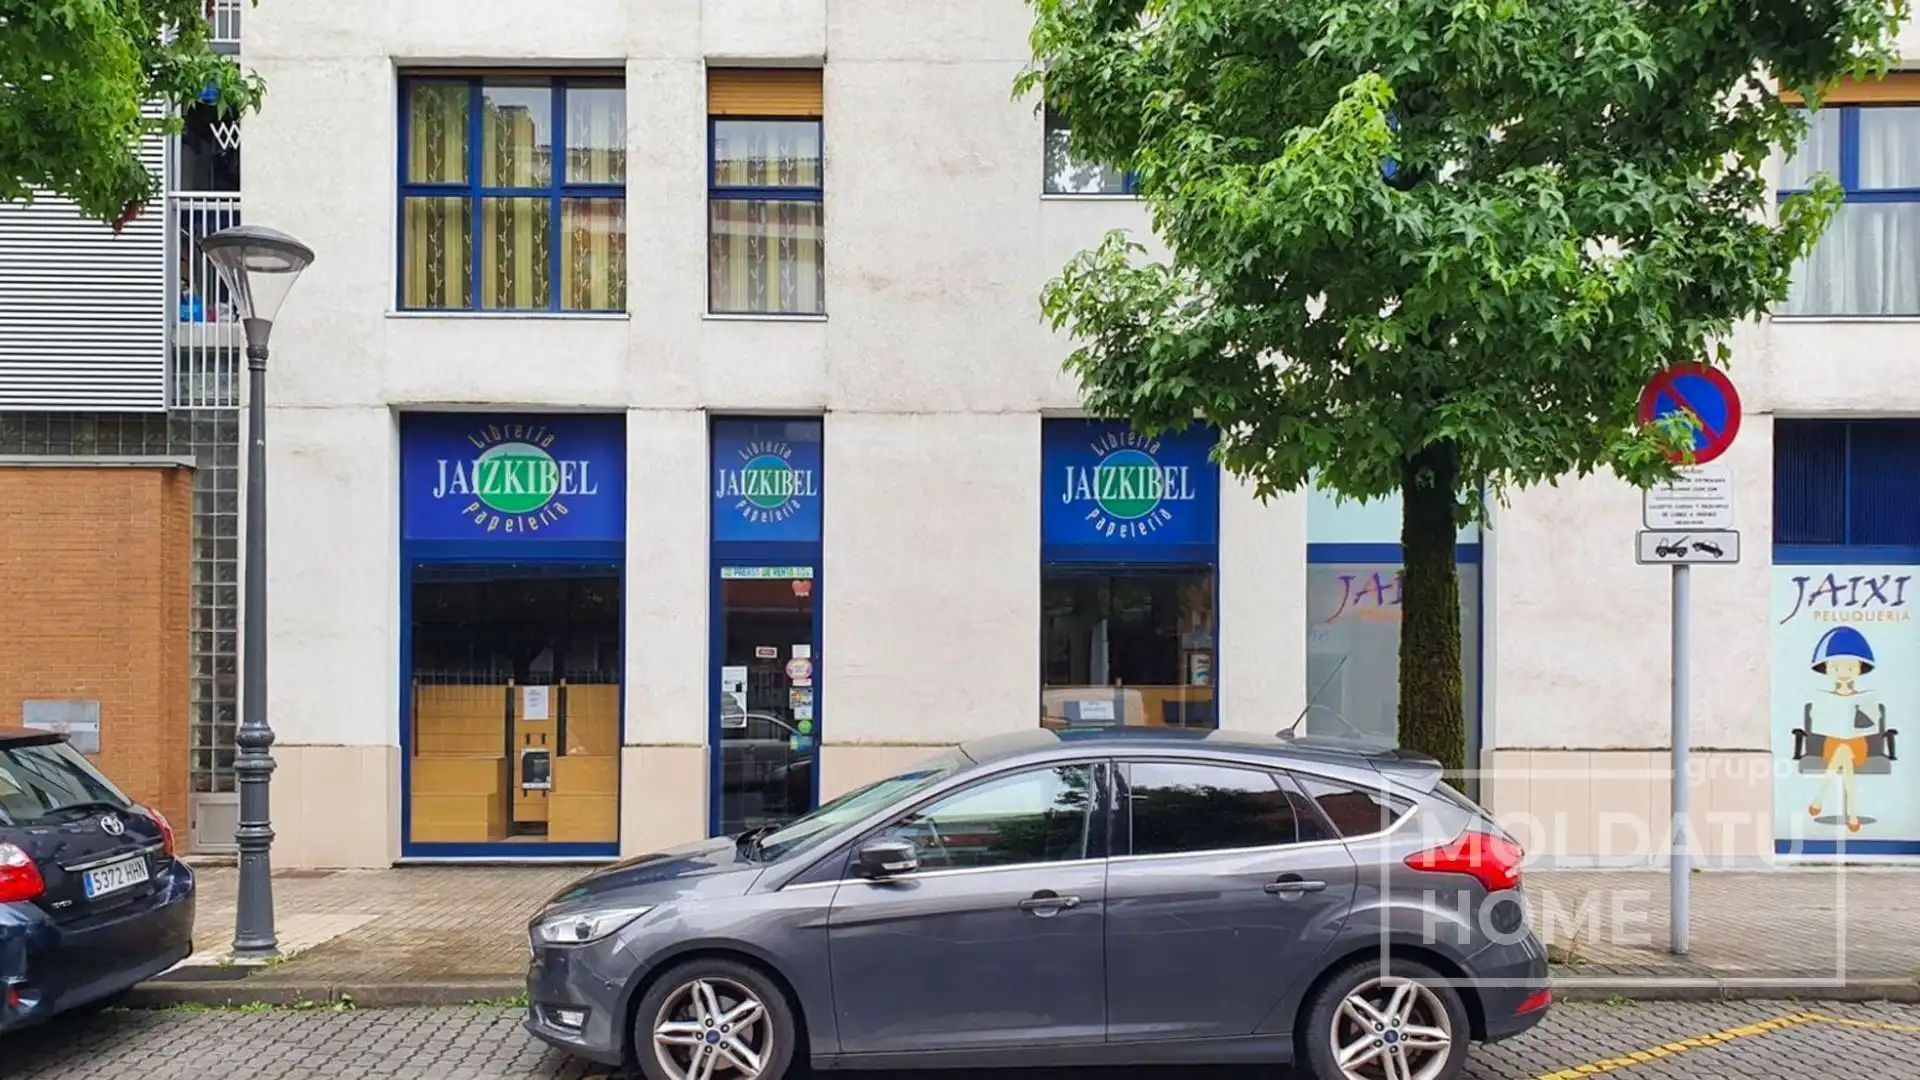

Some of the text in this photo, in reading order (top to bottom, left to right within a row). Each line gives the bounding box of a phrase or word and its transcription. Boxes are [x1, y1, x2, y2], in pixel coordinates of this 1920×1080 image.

[432, 459, 598, 498] JAIZKIBEL
[716, 468, 817, 498] JAIZKIBEL
[1062, 465, 1196, 504] JAIZKIBEL
[1325, 570, 1403, 624] JAI
[1780, 573, 1912, 625] JAIXI
[93, 867, 124, 890] 5372
